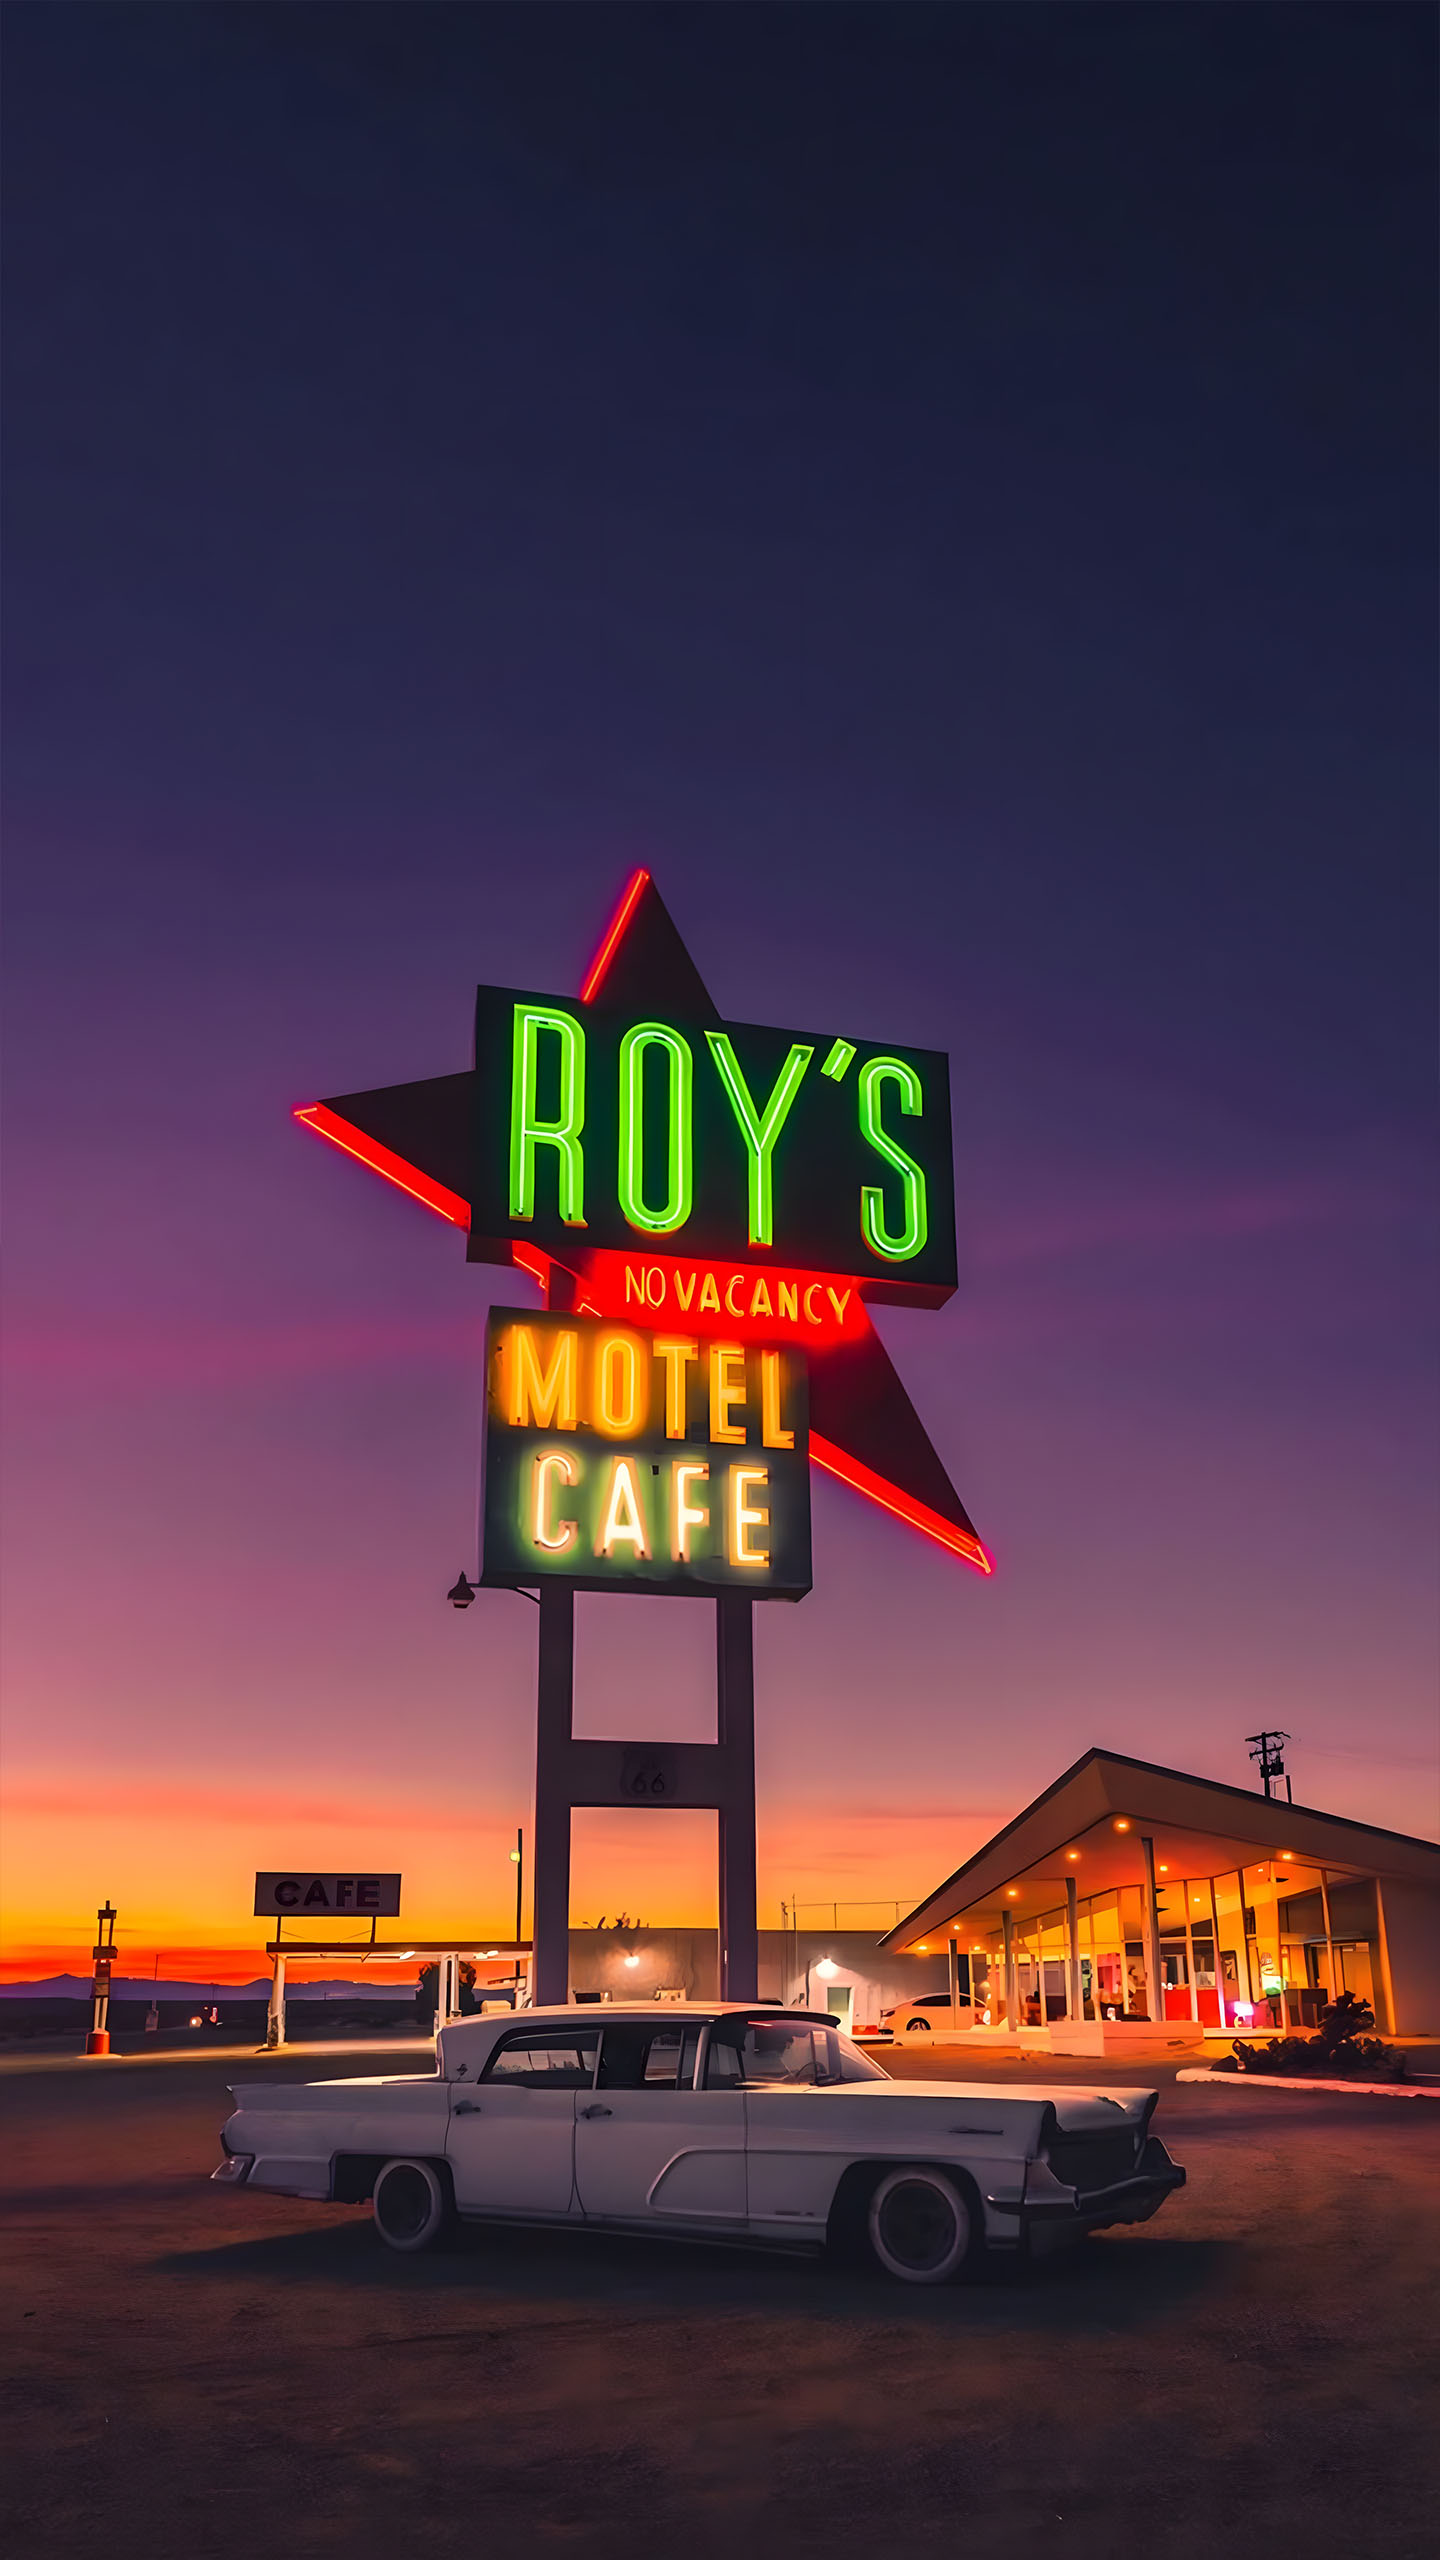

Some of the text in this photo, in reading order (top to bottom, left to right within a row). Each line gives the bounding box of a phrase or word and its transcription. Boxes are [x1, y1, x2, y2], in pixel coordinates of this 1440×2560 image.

[508, 1003, 928, 1262] ROY'S
[625, 1265, 851, 1325] NO VACANCY
[509, 1325, 795, 1449] MOTEL
[532, 1449, 770, 1568] CAFE
[631, 1770, 665, 1793] 66
[274, 1880, 380, 1907] CAFE
